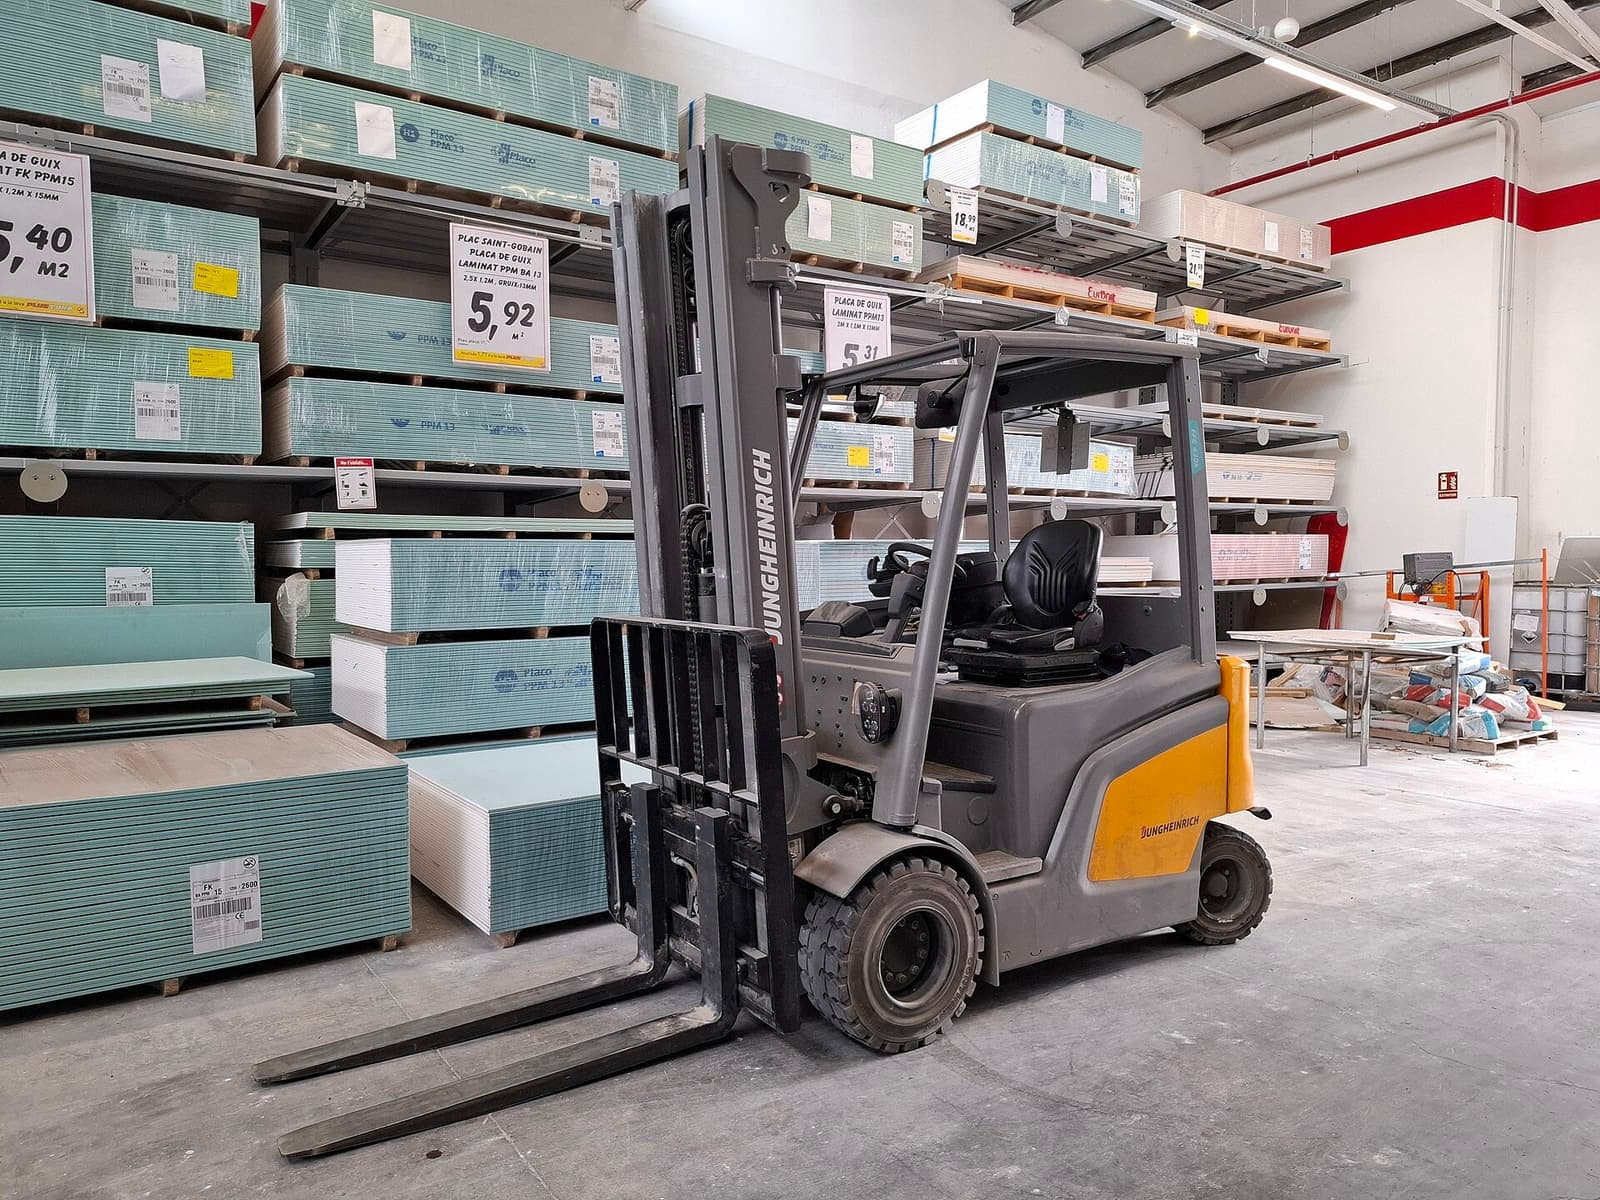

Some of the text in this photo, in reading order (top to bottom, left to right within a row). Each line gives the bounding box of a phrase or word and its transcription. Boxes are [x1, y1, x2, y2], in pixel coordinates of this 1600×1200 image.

[11, 153, 27, 163] DE
[31, 156, 61, 170] GUIX
[15, 168, 31, 179] FK
[34, 171, 76, 186] PPM15
[6, 188, 24, 196] 1,2M
[35, 192, 59, 201] 15MM
[25, 224, 73, 253] 40
[458, 234, 543, 254] PLAC SAINT-GOBAIN
[469, 249, 532, 265] PLACA DE GUIX
[458, 259, 542, 279] LAMINAT PPM BA 13
[480, 277, 494, 285] 1,2M
[834, 296, 883, 310] PLACA DE GUIX
[503, 301, 535, 327] 92
[832, 308, 885, 322] LAMINAT PPM13
[864, 345, 879, 361] 31
[421, 421, 441, 430] PPM
[752, 449, 783, 646] JUNGHEINRICH
[1140, 815, 1200, 840] JUNGHEINRICH
[203, 883, 213, 891] FK
[214, 887, 223, 896] 15
